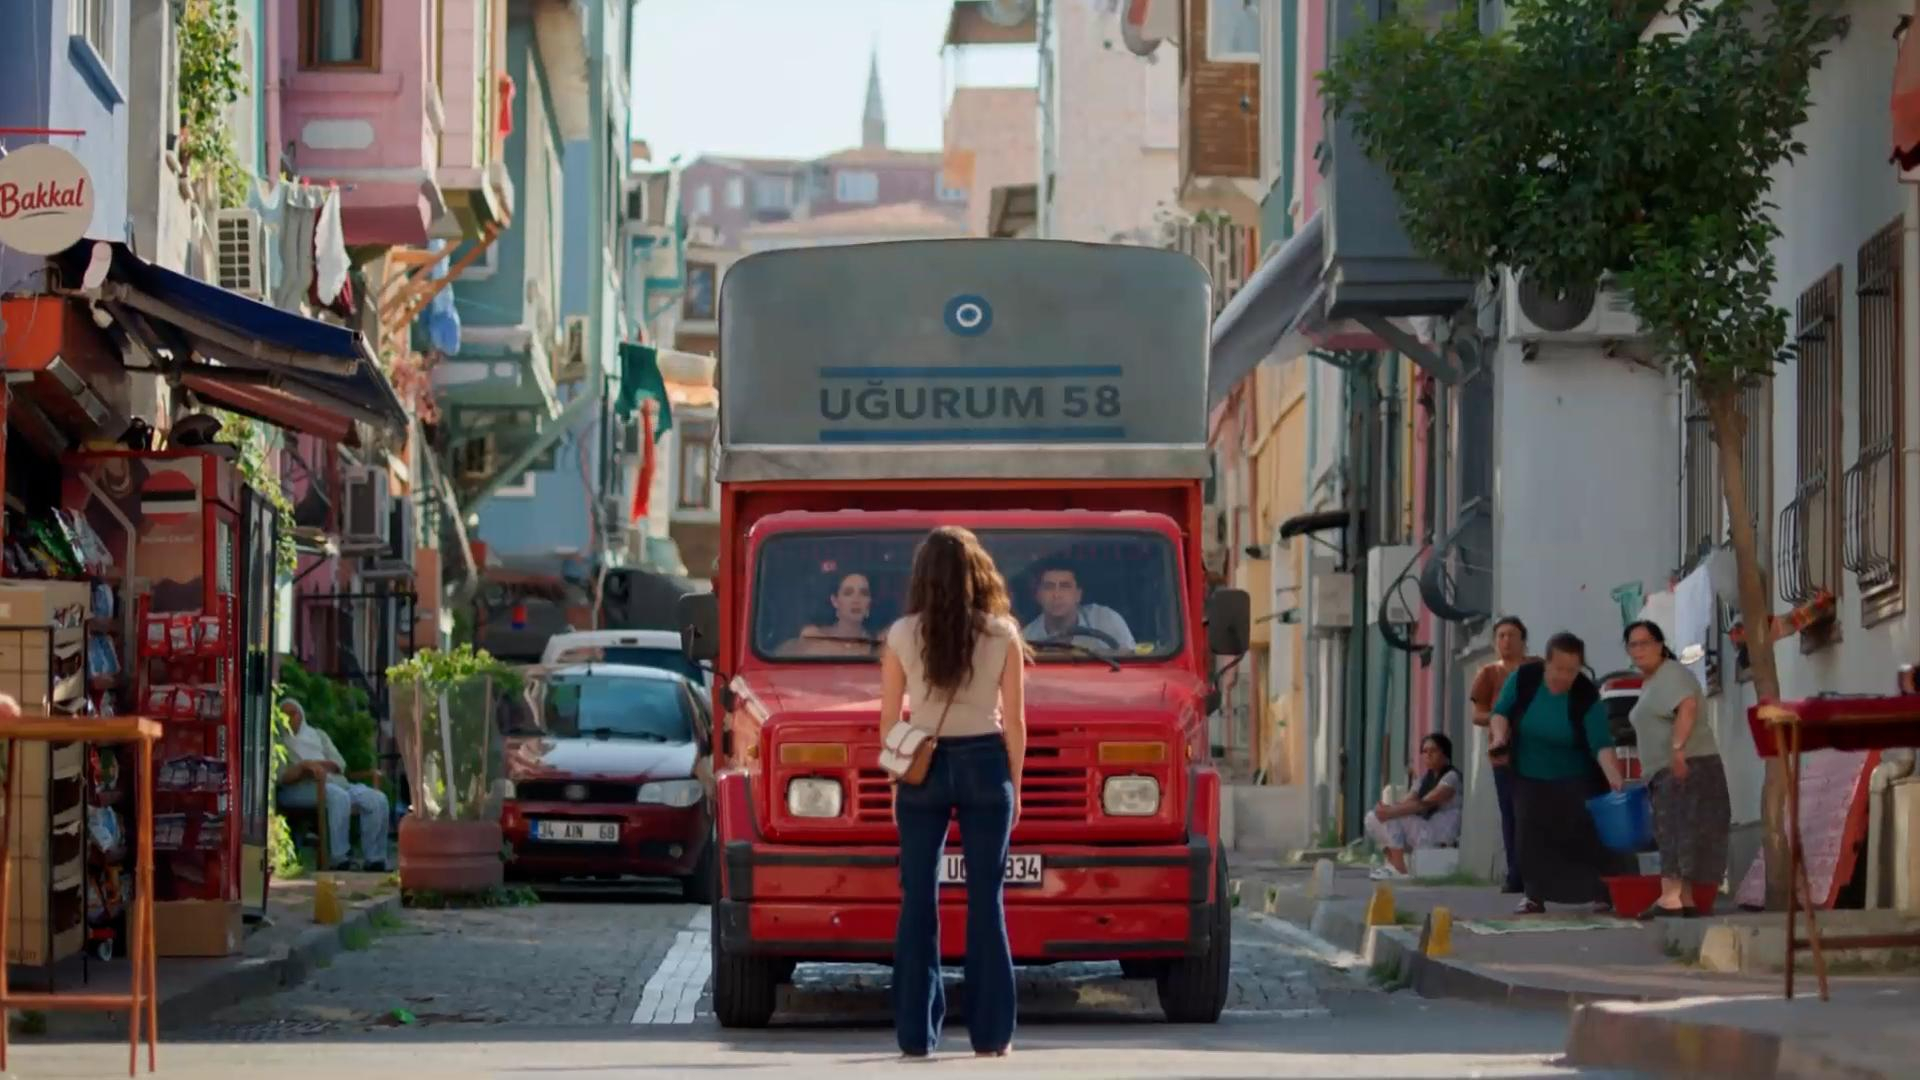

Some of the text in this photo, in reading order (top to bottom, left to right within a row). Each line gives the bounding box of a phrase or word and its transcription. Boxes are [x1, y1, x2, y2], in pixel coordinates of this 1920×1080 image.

[0, 177, 84, 219] Bakkal
[820, 379, 1121, 421] UĞURUM 58
